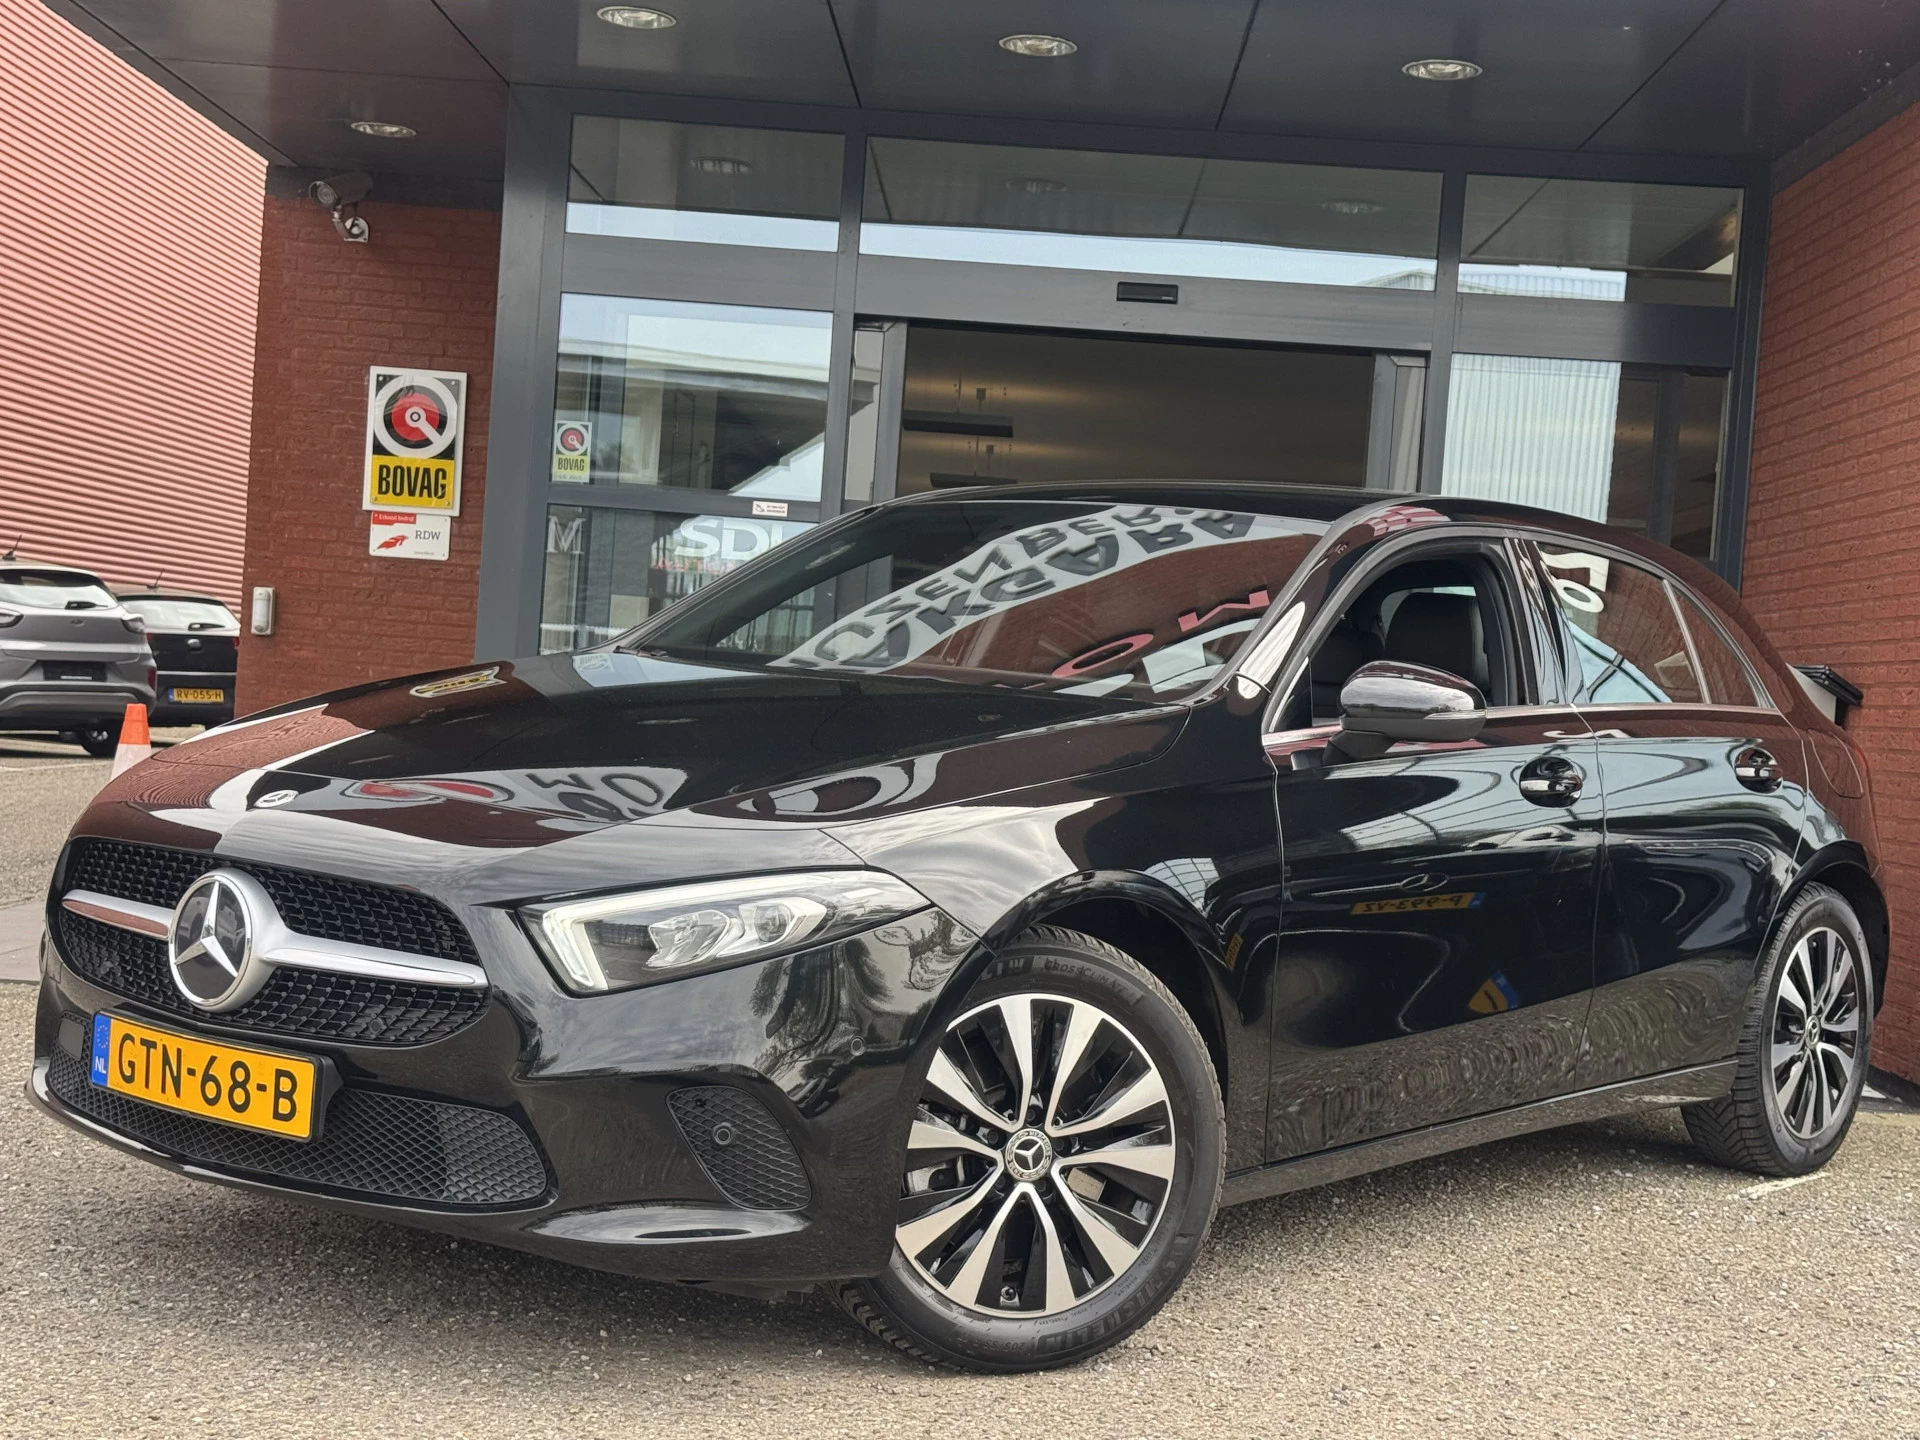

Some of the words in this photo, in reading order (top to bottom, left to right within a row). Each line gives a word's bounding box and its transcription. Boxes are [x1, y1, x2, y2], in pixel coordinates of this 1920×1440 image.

[558, 457, 585, 472] BOVAG
[377, 464, 447, 500] BOVAG
[415, 530, 442, 541] RDW
[176, 689, 222, 700] RV-055-H
[95, 1055, 107, 1075] NL
[118, 1032, 298, 1123] GTN-68-B
